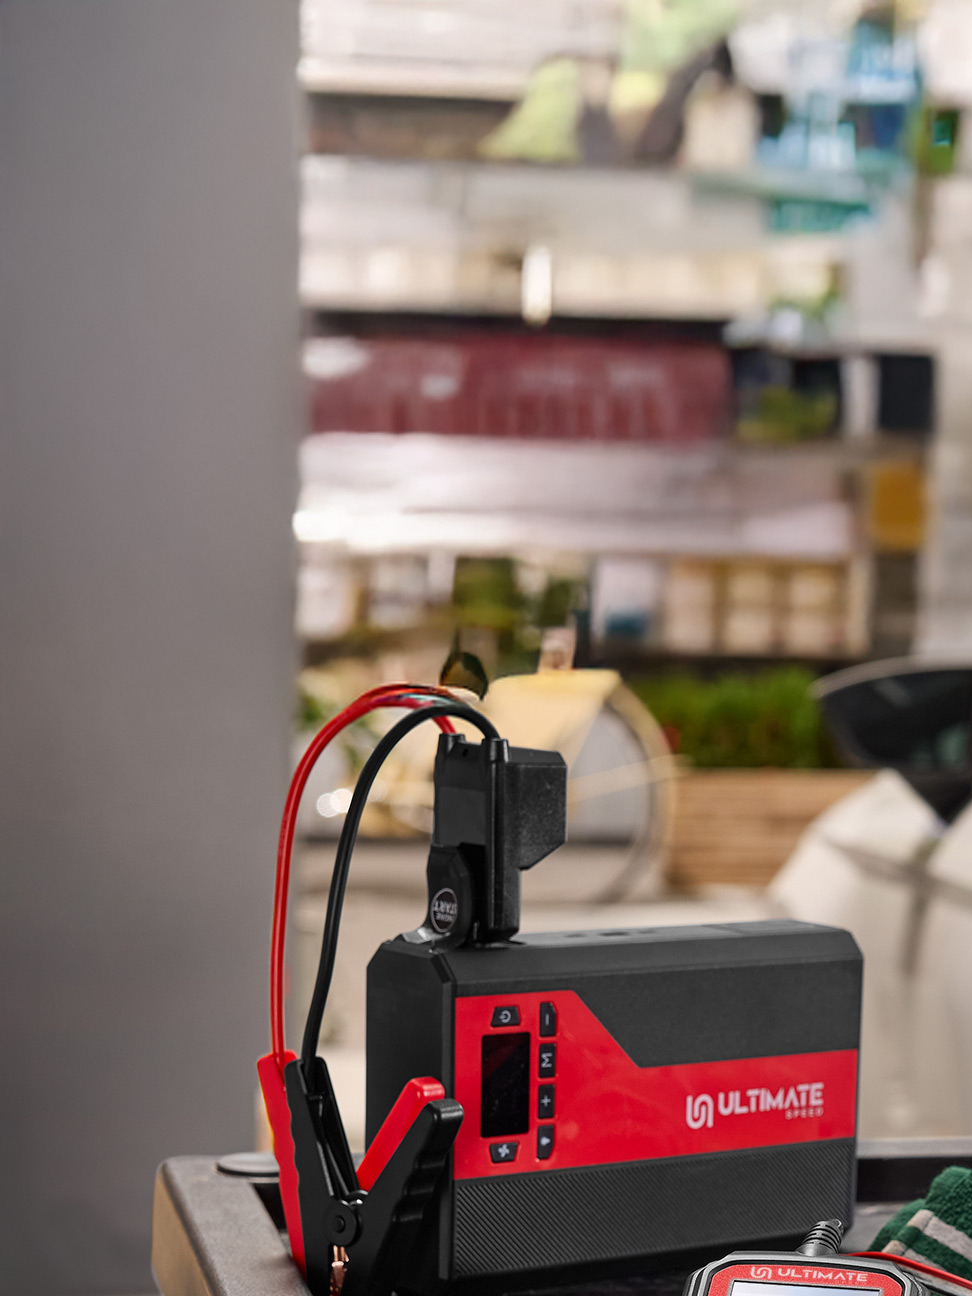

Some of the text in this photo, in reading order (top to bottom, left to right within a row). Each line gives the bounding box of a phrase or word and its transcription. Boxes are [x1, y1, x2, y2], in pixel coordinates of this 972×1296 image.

[717, 1081, 825, 1116] ULTIMATE
[785, 1107, 824, 1120] SPEED
[777, 1267, 869, 1282] ULTIMATE
